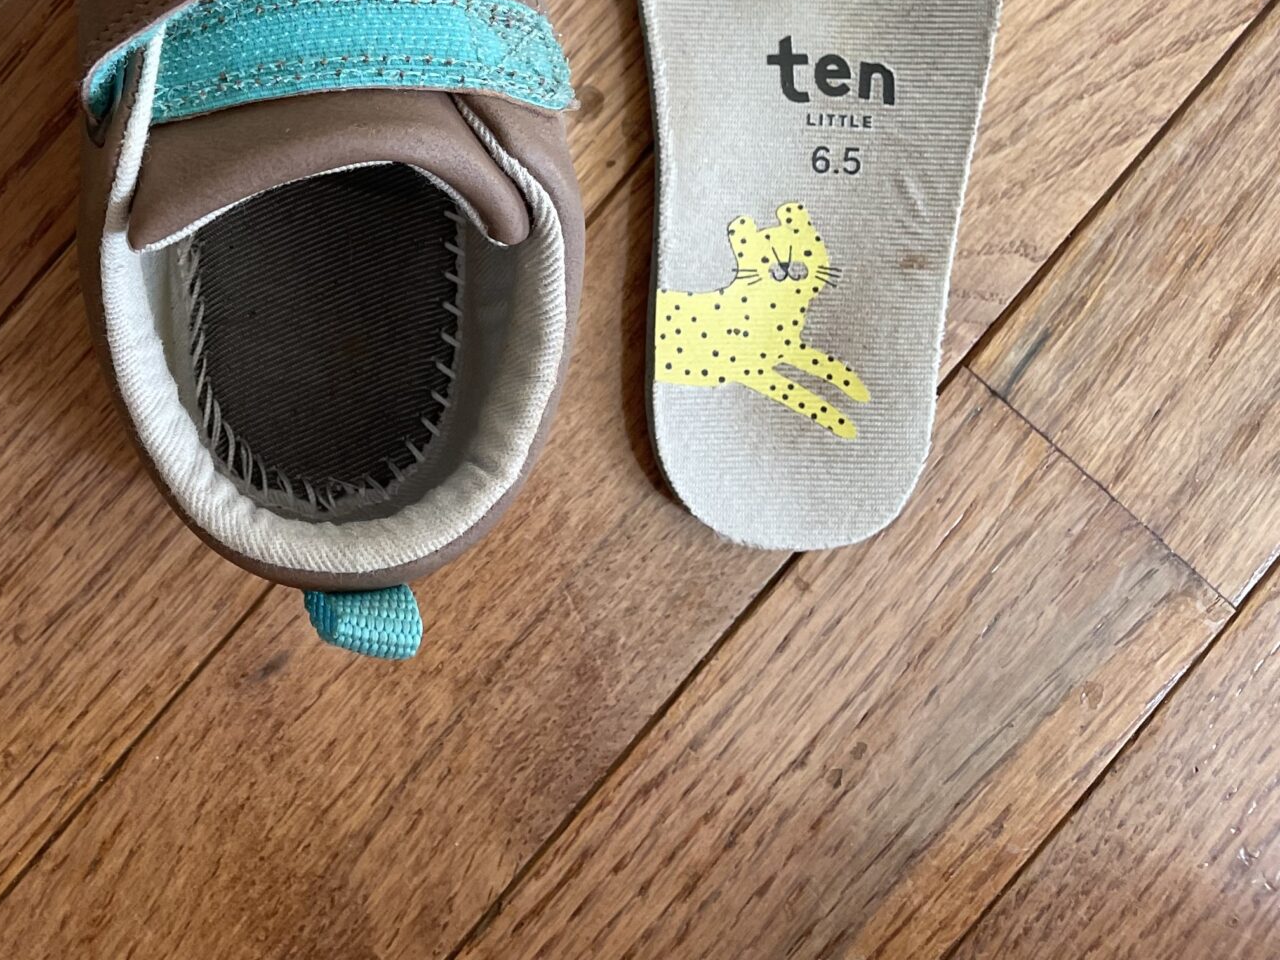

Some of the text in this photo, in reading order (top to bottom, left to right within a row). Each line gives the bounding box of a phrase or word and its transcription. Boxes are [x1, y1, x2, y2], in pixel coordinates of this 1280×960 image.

[766, 35, 896, 106] ten
[806, 113, 873, 129] LITTLE
[811, 145, 862, 176] 6.5
